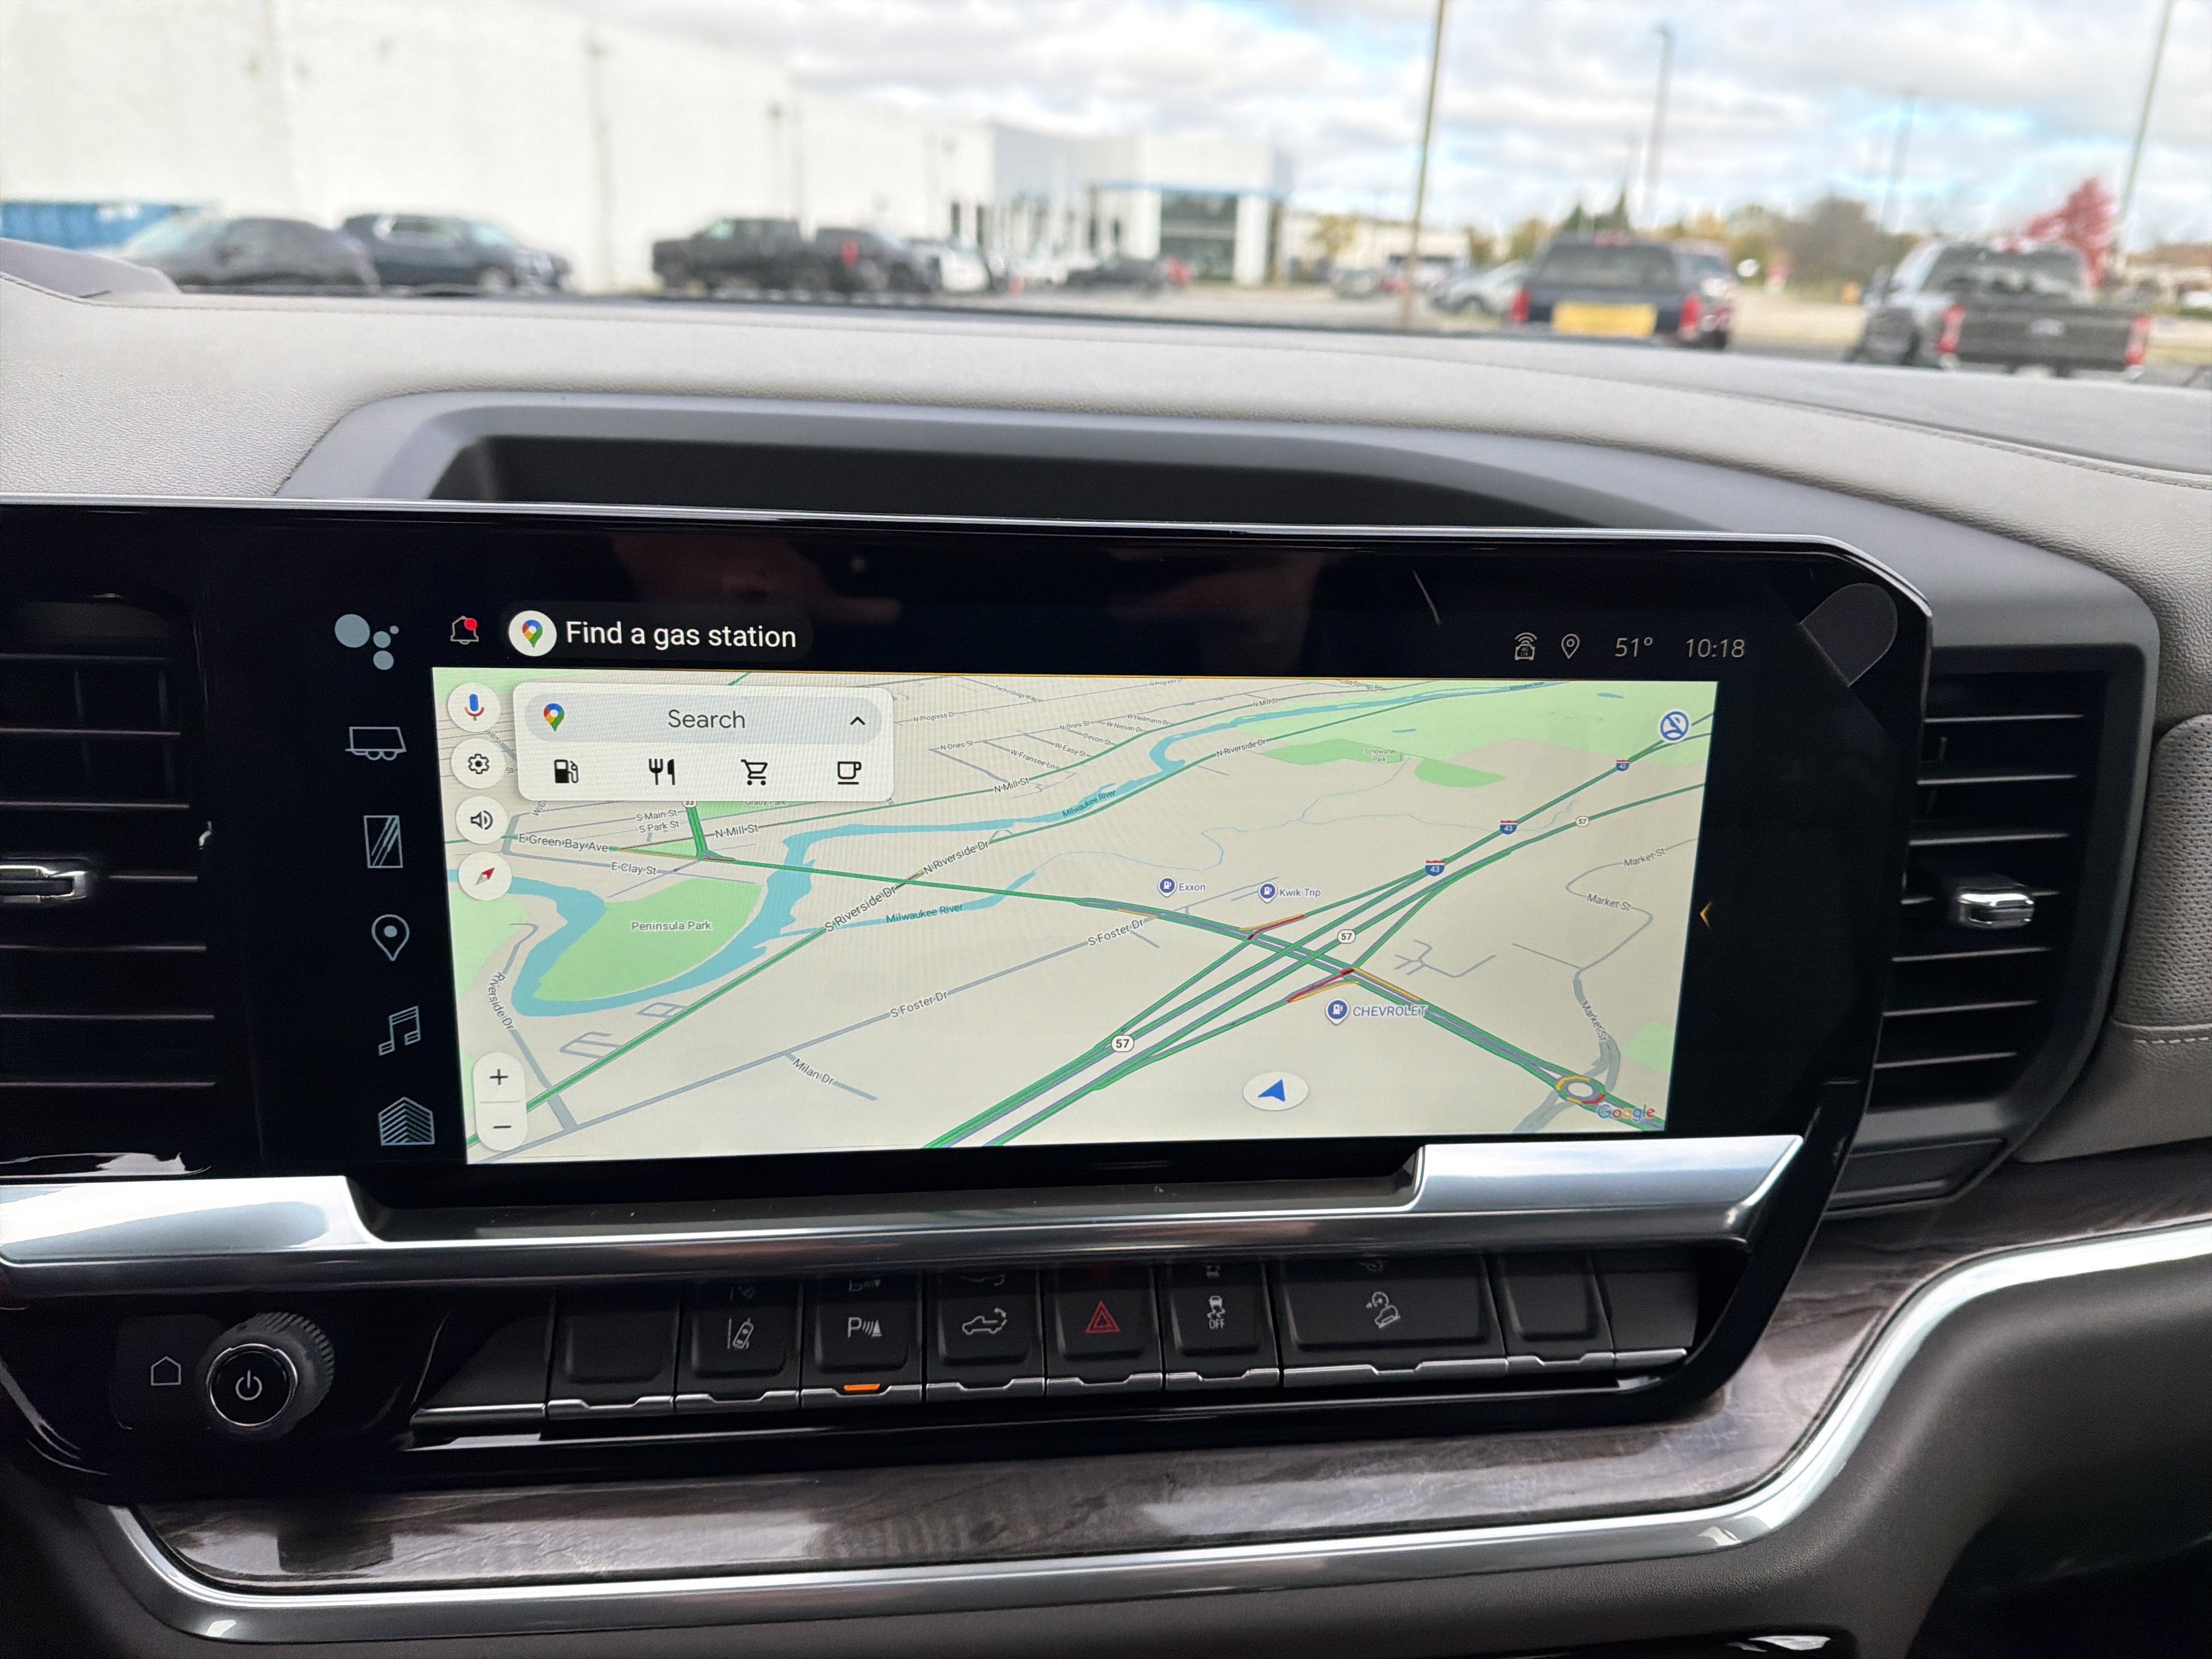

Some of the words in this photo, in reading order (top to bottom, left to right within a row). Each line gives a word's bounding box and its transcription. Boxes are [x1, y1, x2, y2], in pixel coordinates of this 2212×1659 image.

[566, 620, 622, 644] Find
[631, 627, 645, 645] a
[654, 627, 699, 650] gas
[708, 625, 796, 647] station
[1686, 638, 1745, 658] 10:18
[995, 685, 1025, 699] Technology
[1025, 694, 1037, 702] Way
[668, 709, 745, 729] Search
[920, 713, 947, 722] Progress
[1134, 714, 1161, 725] Heilmann
[1114, 724, 1135, 732] Niesen
[1084, 733, 1101, 744] Devon
[1062, 744, 1079, 758] Easy
[1224, 742, 1257, 755] Riverside
[1018, 751, 1046, 768] Fransee
[994, 785, 1001, 793] N
[1003, 780, 1019, 791] Mill
[1019, 777, 1029, 786] St
[1062, 796, 1098, 818] Milwaukee
[1097, 790, 1116, 800] River
[644, 811, 666, 820] Main
[647, 822, 667, 832] Park
[668, 821, 680, 829] St
[715, 830, 724, 838] N
[725, 826, 744, 837] Mill
[747, 824, 759, 833] St
[518, 833, 527, 843] E
[529, 835, 561, 847] Green
[565, 839, 585, 851] Bay
[588, 842, 608, 853] Ave
[923, 865, 933, 875] N
[933, 844, 977, 870] Riverside
[978, 840, 989, 850] Dr
[1624, 854, 1654, 867] Market
[1656, 848, 1666, 857] St
[611, 861, 618, 870] E
[620, 862, 644, 875] Clay
[646, 866, 657, 875] St
[1179, 883, 1206, 891] Exxon
[1279, 887, 1301, 896] Kwik
[1304, 888, 1321, 899] Trip
[825, 922, 834, 932] S
[834, 894, 883, 927] Riverside
[883, 885, 896, 898] Dr
[1587, 893, 1620, 909] Market
[1620, 902, 1632, 911] St
[885, 909, 938, 923] Milwaukee
[939, 904, 963, 913] River
[632, 922, 685, 931] Peninsula
[688, 921, 712, 930] Park
[1088, 936, 1096, 946] S
[1097, 924, 1131, 943] Foster
[1132, 919, 1144, 930] Dr
[488, 971, 506, 1017] Riverside
[501, 1017, 515, 1030] Dr
[890, 1008, 899, 1018] S
[900, 996, 934, 1015] Foster
[935, 990, 949, 1002] Dr
[1353, 1006, 1426, 1017] CHEVROLET
[1580, 1000, 1603, 1034] Market
[1598, 1028, 1607, 1041] St
[1116, 1039, 1130, 1048] 57
[793, 1058, 820, 1080] Milan
[821, 1073, 834, 1086] Dr
[1597, 1104, 1655, 1121] Google
[1209, 1319, 1225, 1330] OFF
